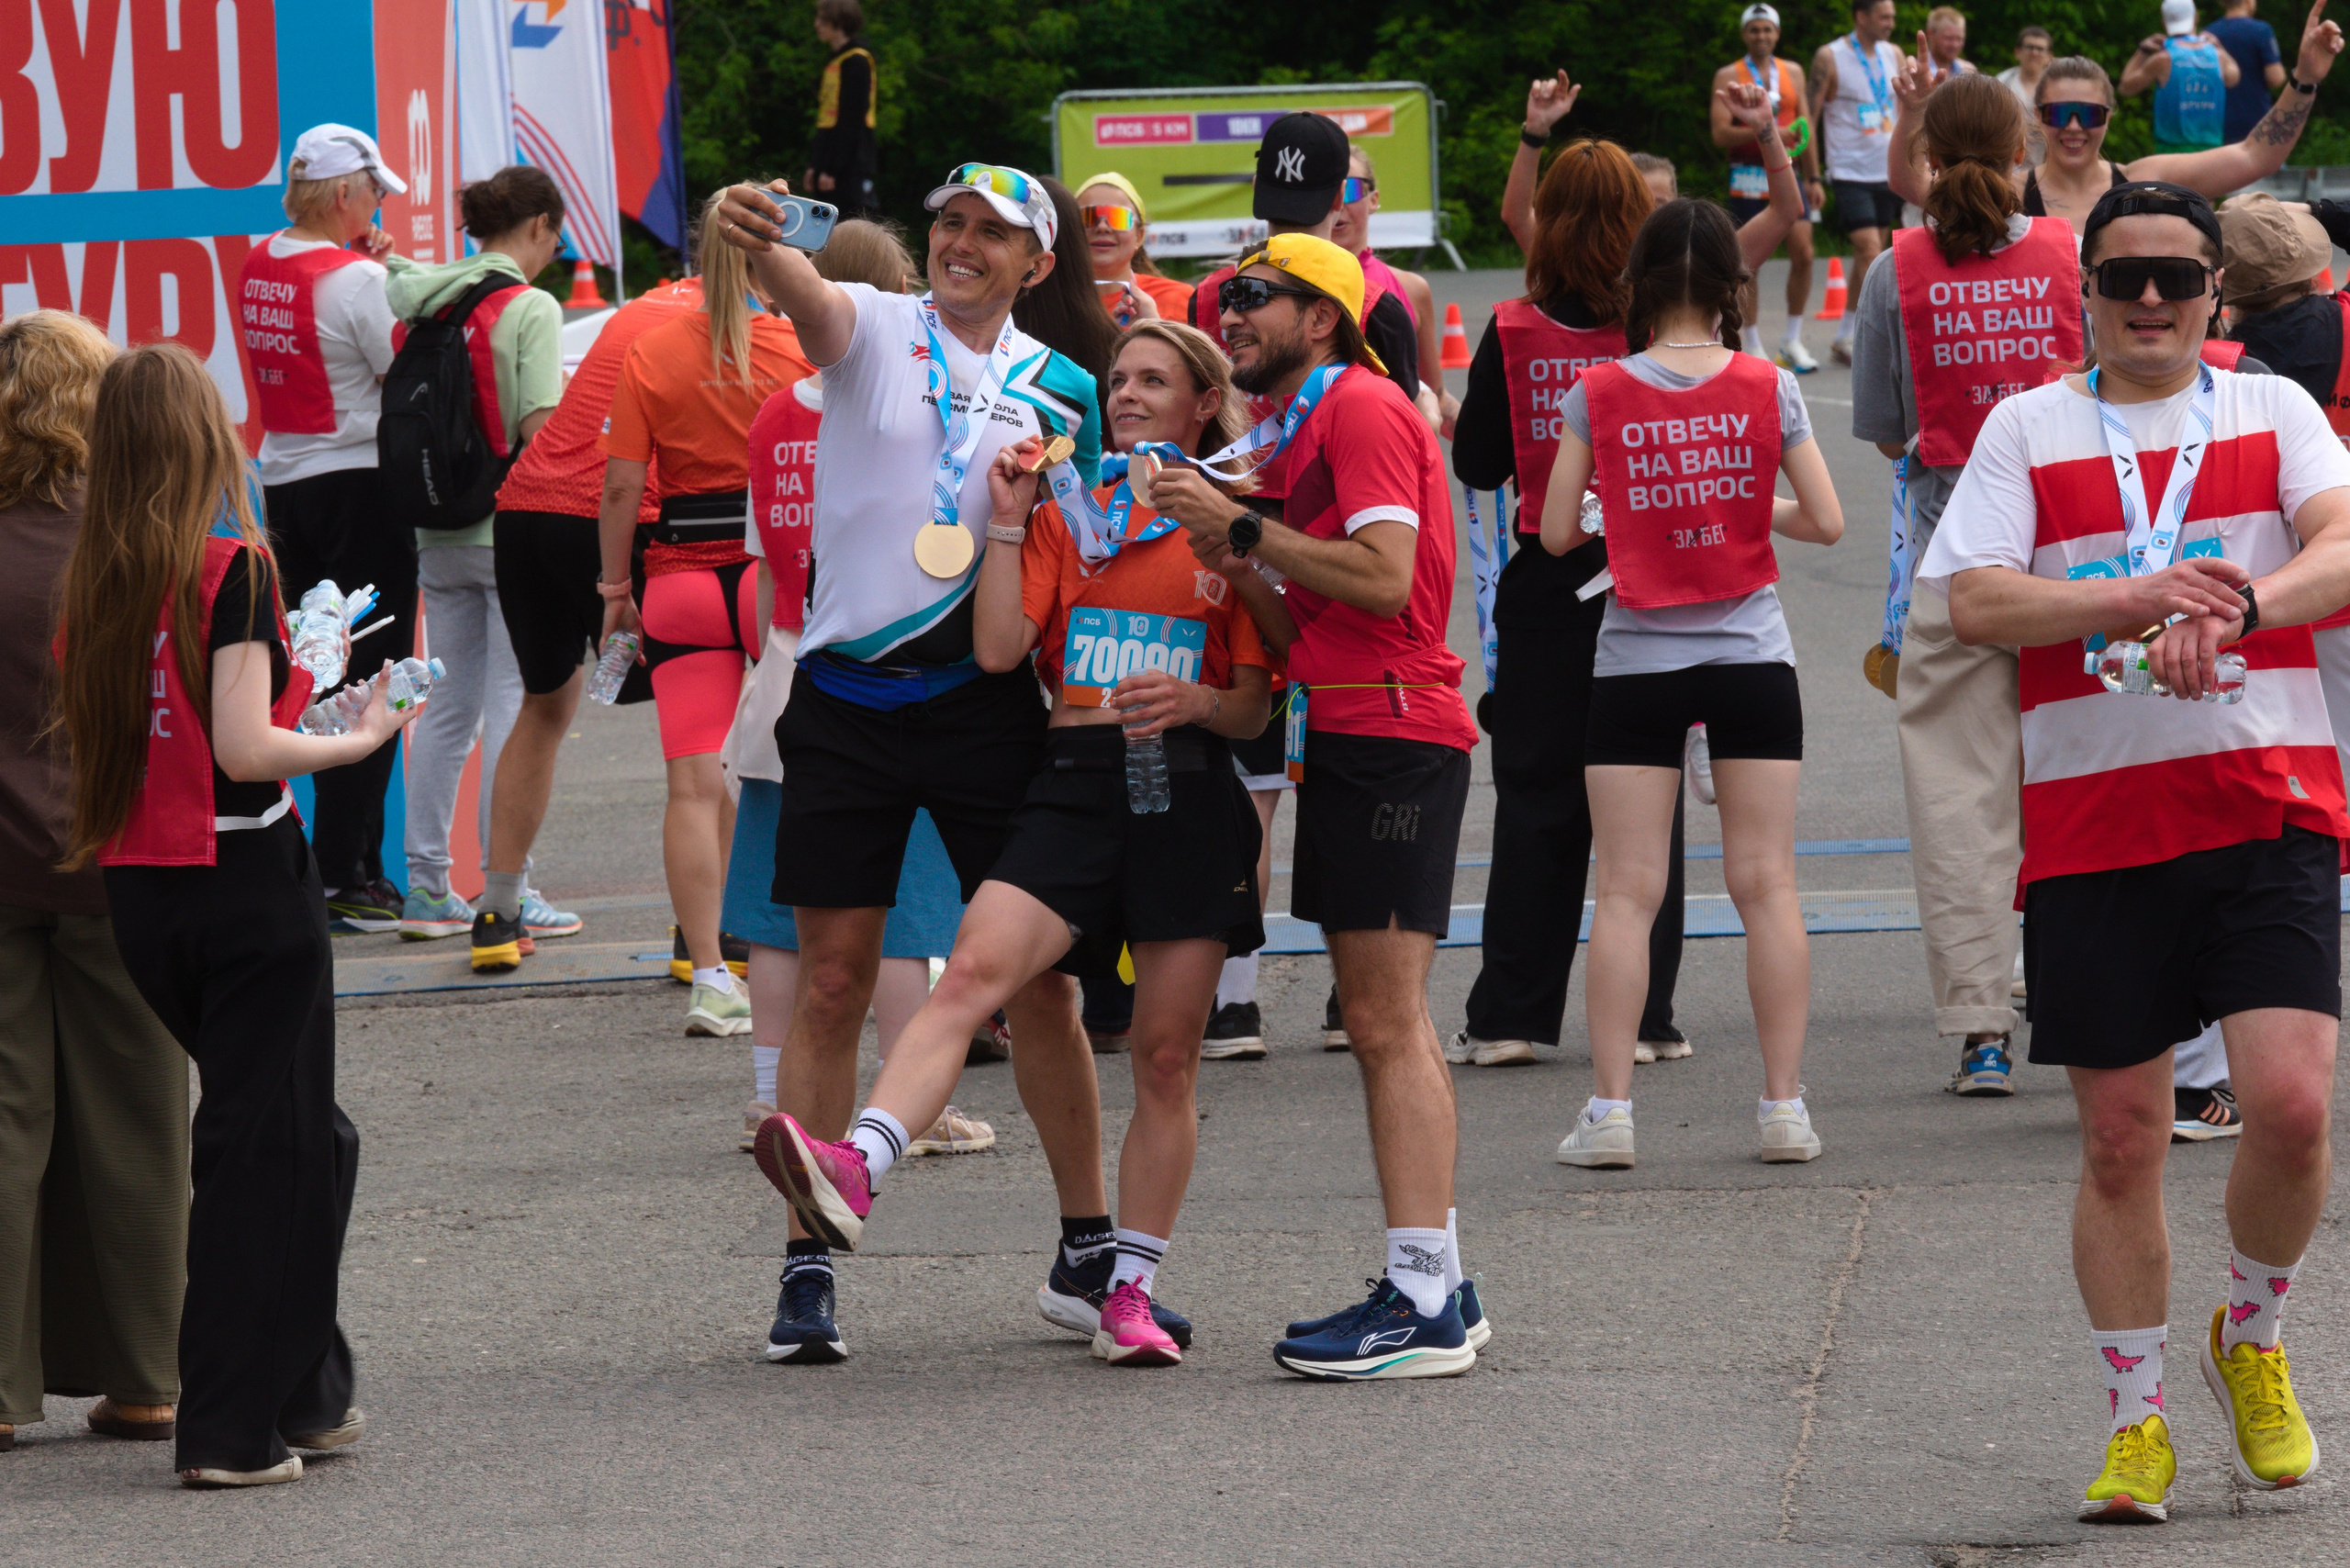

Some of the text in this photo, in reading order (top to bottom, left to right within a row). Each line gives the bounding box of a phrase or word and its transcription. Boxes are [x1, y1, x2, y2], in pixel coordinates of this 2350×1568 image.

[1275, 146, 1305, 182] NY
[244, 278, 297, 304] ОТВЕЧУ
[1929, 276, 2051, 306] ОТВЕЧУ
[260, 306, 294, 330] ВАШ
[1933, 306, 2053, 336] НА ВАШ
[1932, 336, 2057, 366] ВОПРОС
[1621, 413, 1750, 447] ОТВЕЧУ
[421, 448, 439, 506] HEAD
[1627, 445, 1752, 479] НА ВАШ
[776, 472, 805, 497] НА
[1628, 476, 1755, 510] ВОПРОС
[1193, 570, 1227, 606] 10
[1083, 618, 1101, 626] ПСБ
